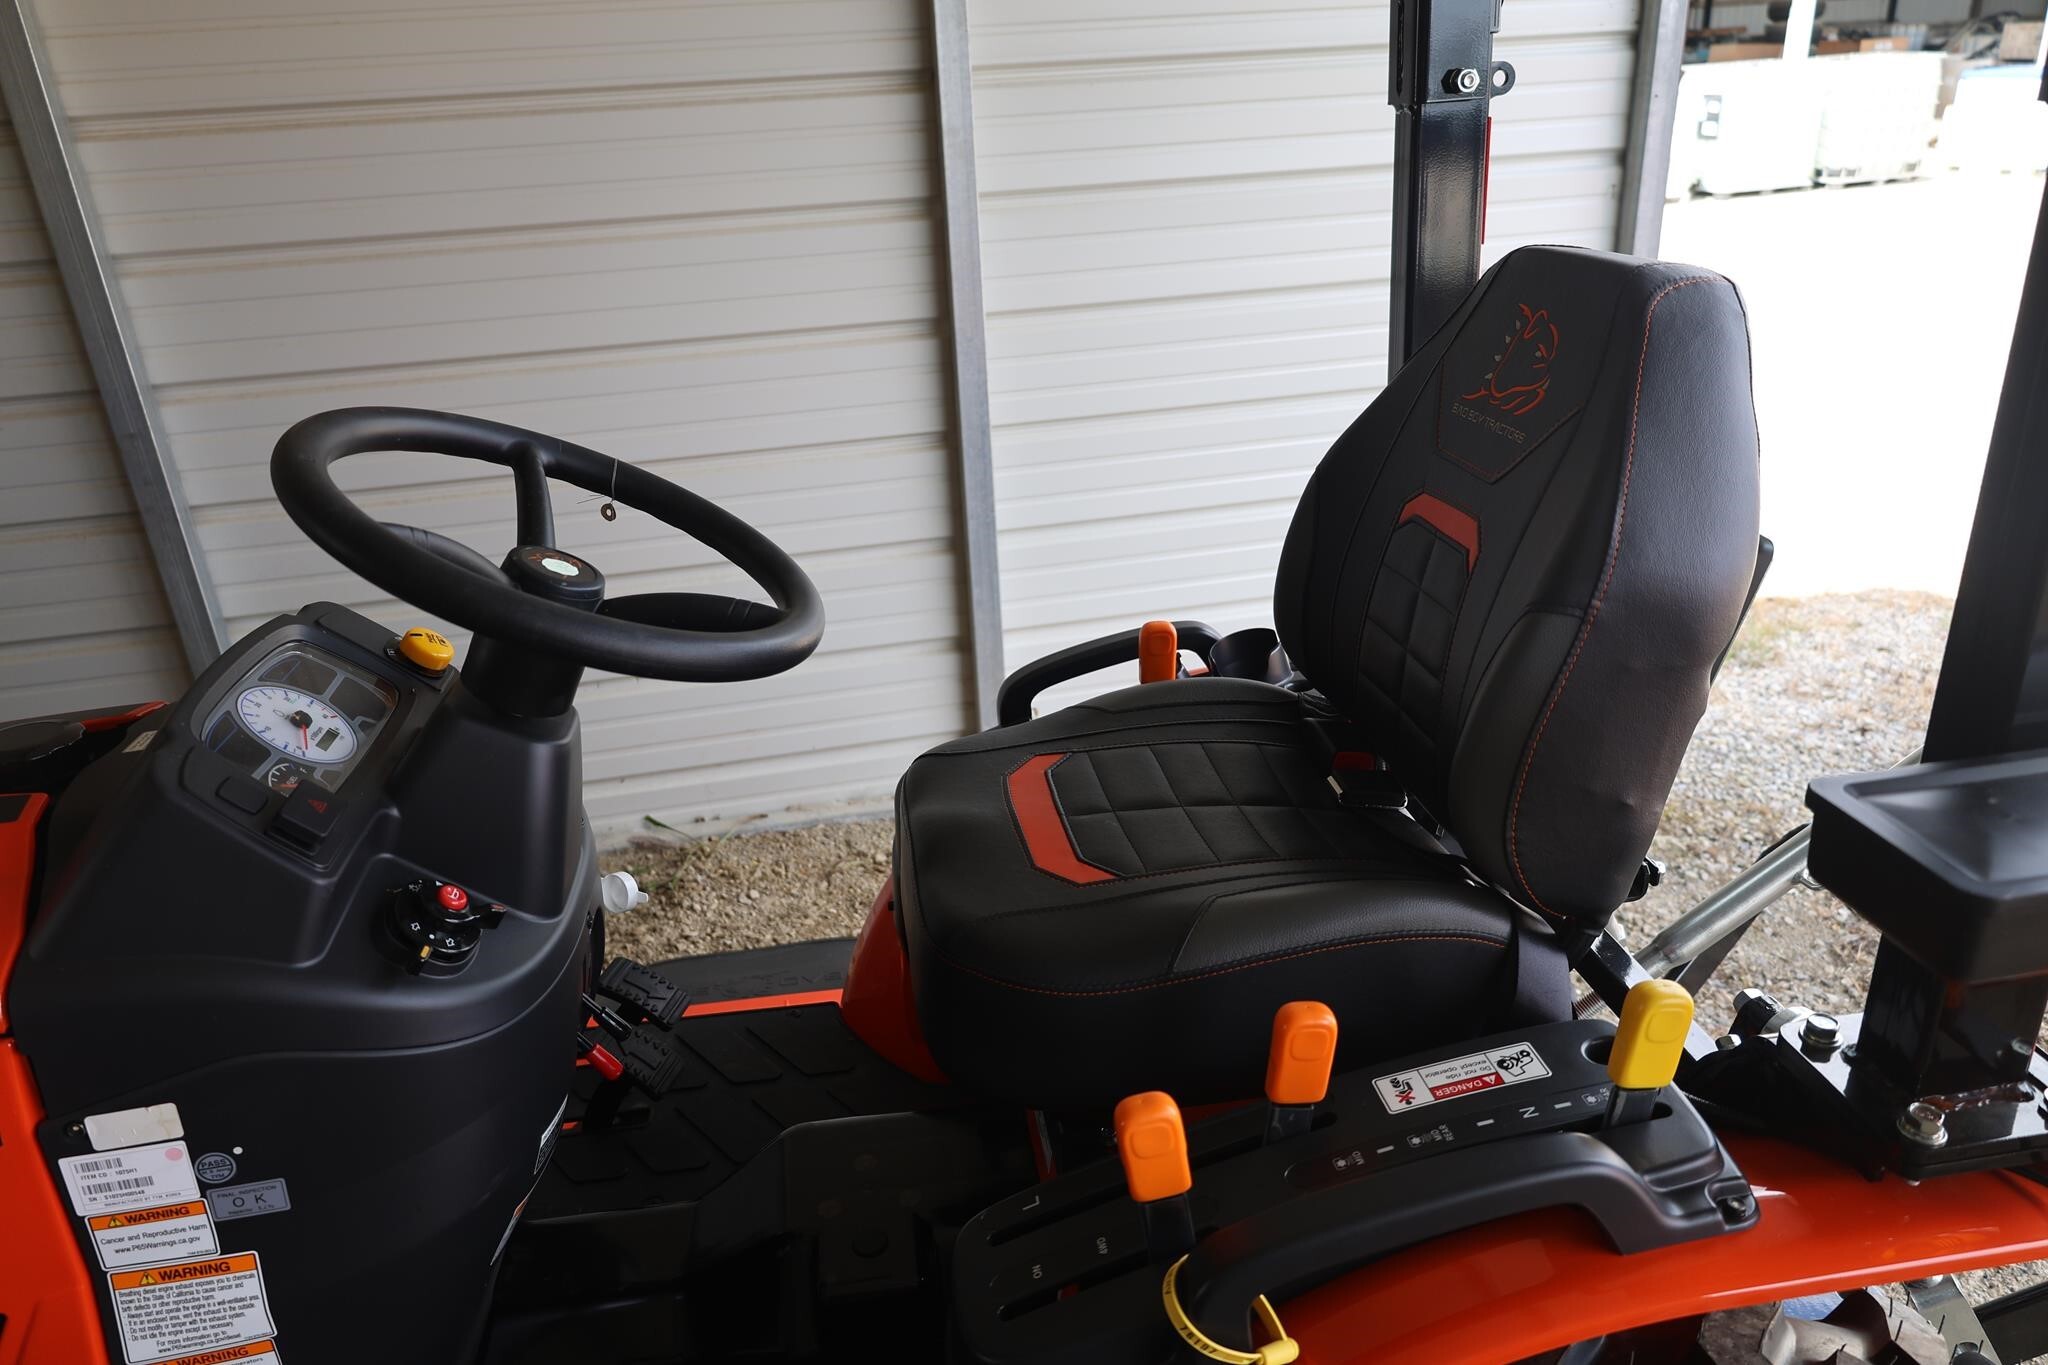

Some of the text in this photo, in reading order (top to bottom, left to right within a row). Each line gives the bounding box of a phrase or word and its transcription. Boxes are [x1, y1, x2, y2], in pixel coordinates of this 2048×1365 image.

[1424, 1059, 1487, 1079] except operator
[1444, 1064, 1492, 1081] Do not ride
[1433, 1079, 1483, 1098] DANGER
[1519, 1106, 1540, 1118] N
[200, 1159, 227, 1168] PASS
[1351, 1151, 1365, 1166] MID
[239, 1185, 277, 1195] INSPECTION
[1022, 1195, 1040, 1211] L
[125, 1206, 190, 1224] WARNING
[100, 1237, 125, 1245] Cancer
[142, 1227, 187, 1239] Reproductive
[159, 1262, 230, 1281] WARNING
[195, 1280, 214, 1288] exposes
[233, 1273, 255, 1281] chemicals
[165, 1307, 181, 1315] operate
[192, 1303, 206, 1311] engine
[218, 1296, 248, 1306] well-ventilated
[172, 1296, 200, 1305] reproductive
[147, 1315, 167, 1324] enclosed
[148, 1323, 163, 1331] modify
[171, 1320, 187, 1328] tamper
[168, 1328, 184, 1337] engine
[185, 1326, 200, 1334] except
[182, 1333, 211, 1342] information
[177, 1347, 248, 1365] WARNING
